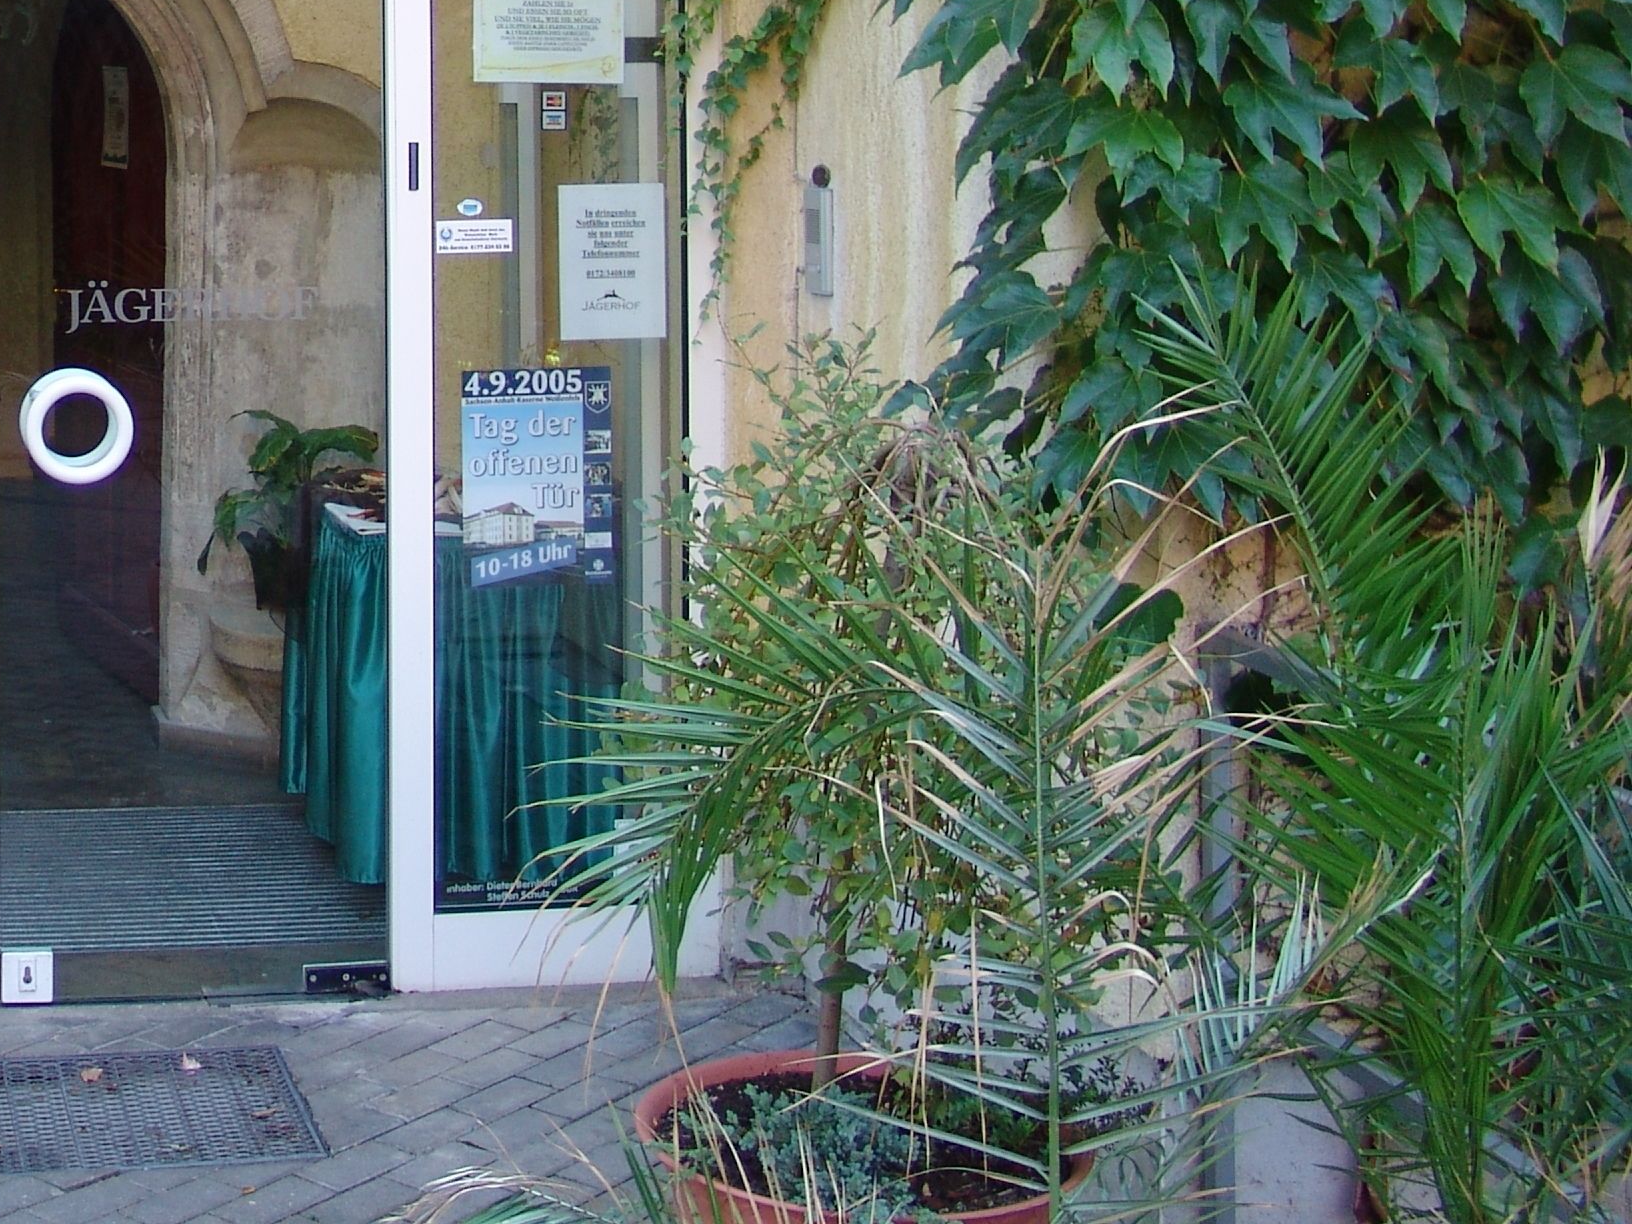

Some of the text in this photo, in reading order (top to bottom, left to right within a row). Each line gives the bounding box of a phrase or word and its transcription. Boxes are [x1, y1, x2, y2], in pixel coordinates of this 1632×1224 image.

[65, 280, 319, 334] JÄGERHOF
[464, 368, 582, 396] 4.9.2005
[469, 409, 576, 446] Tag der
[469, 448, 579, 477] offenen
[531, 481, 580, 509] Tür
[475, 542, 572, 578] 10-18 Uhr
